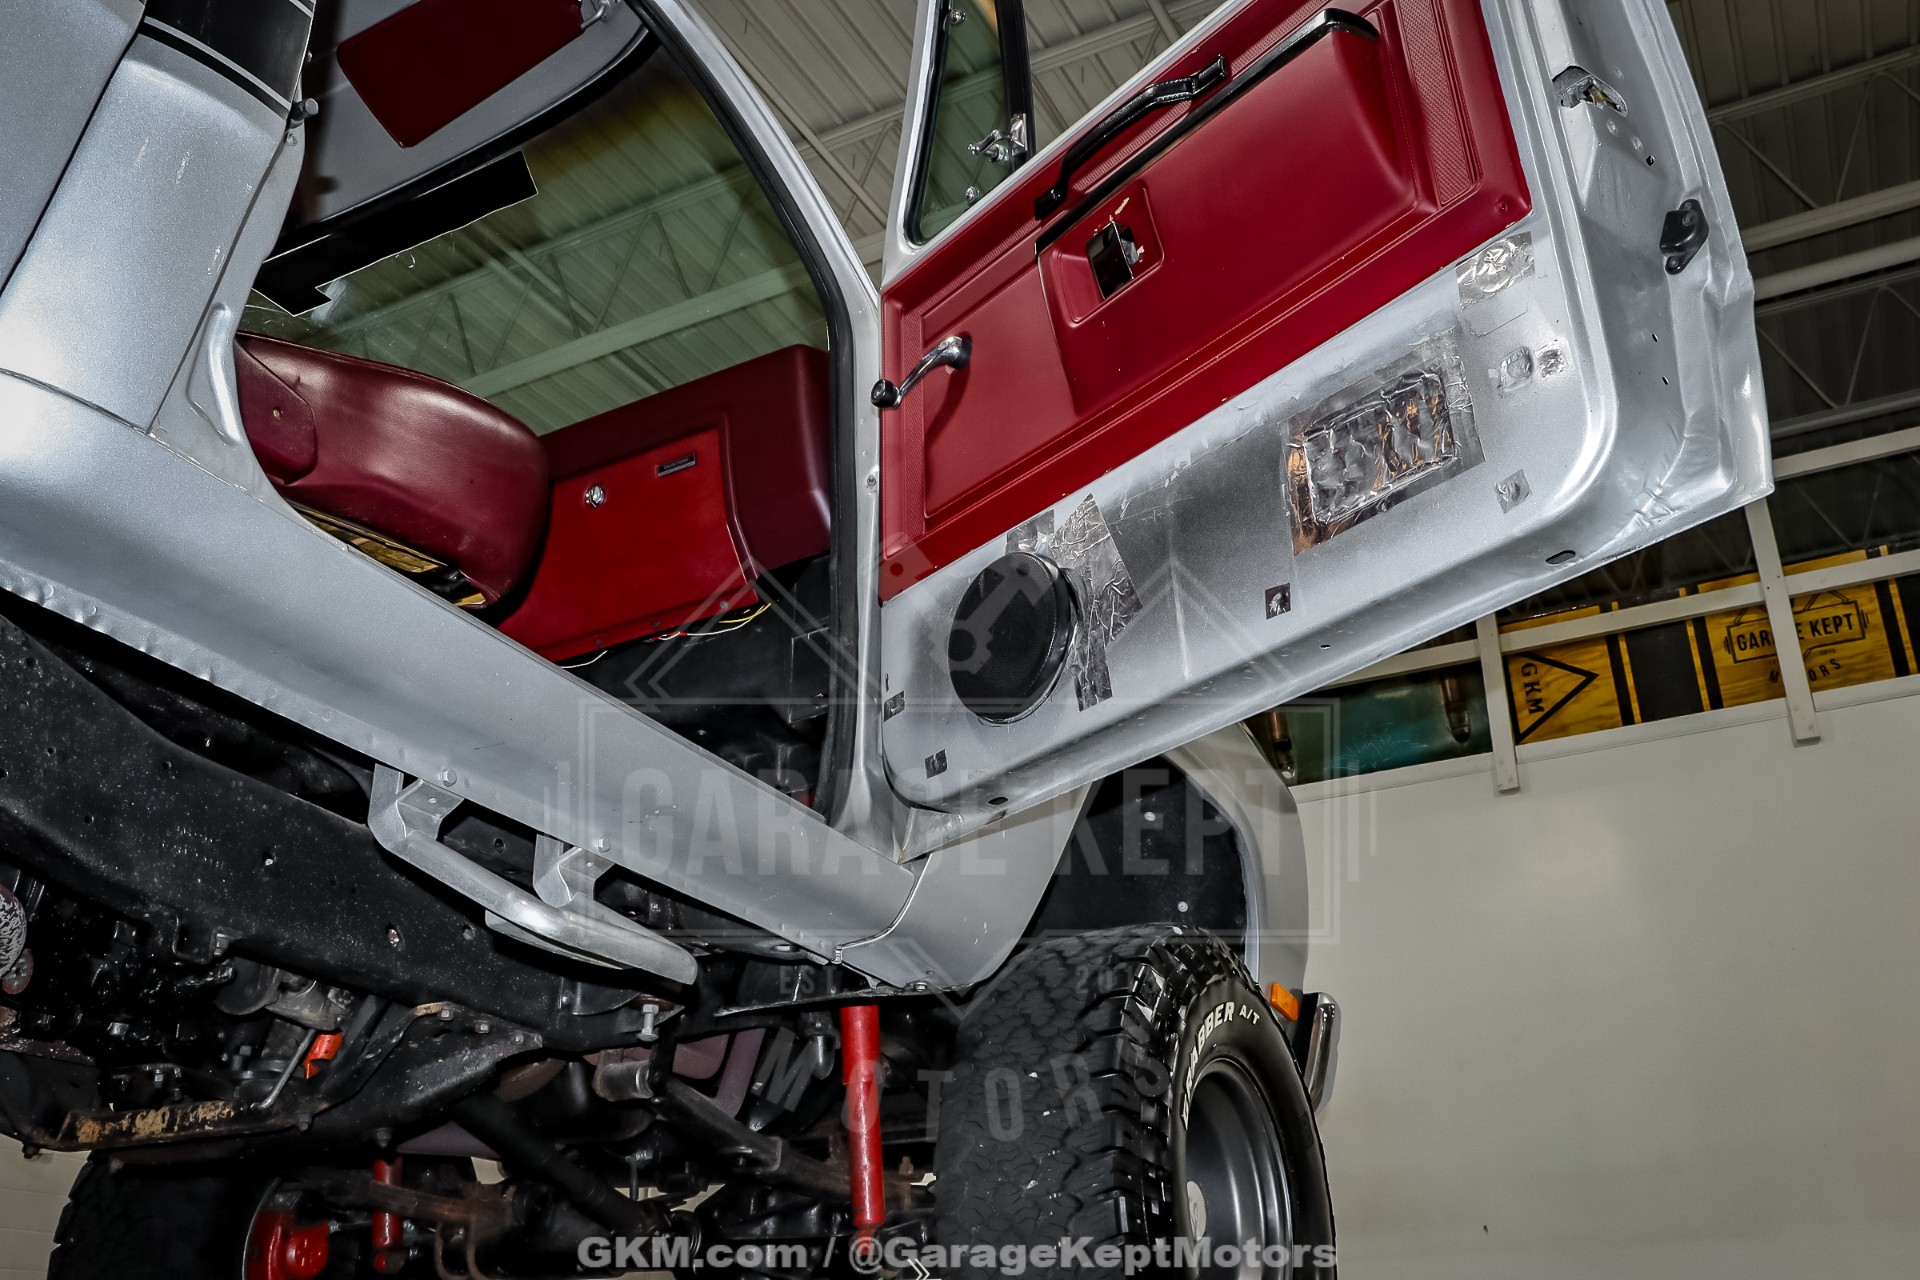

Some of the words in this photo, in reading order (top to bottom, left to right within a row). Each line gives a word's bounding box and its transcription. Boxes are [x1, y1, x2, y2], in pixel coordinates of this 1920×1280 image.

[1736, 623, 1804, 651] GARE
[1809, 613, 1853, 637] KEPT
[1769, 658, 1842, 683] MORS
[1521, 662, 1545, 714] GKM
[1239, 1004, 1260, 1025] A/T
